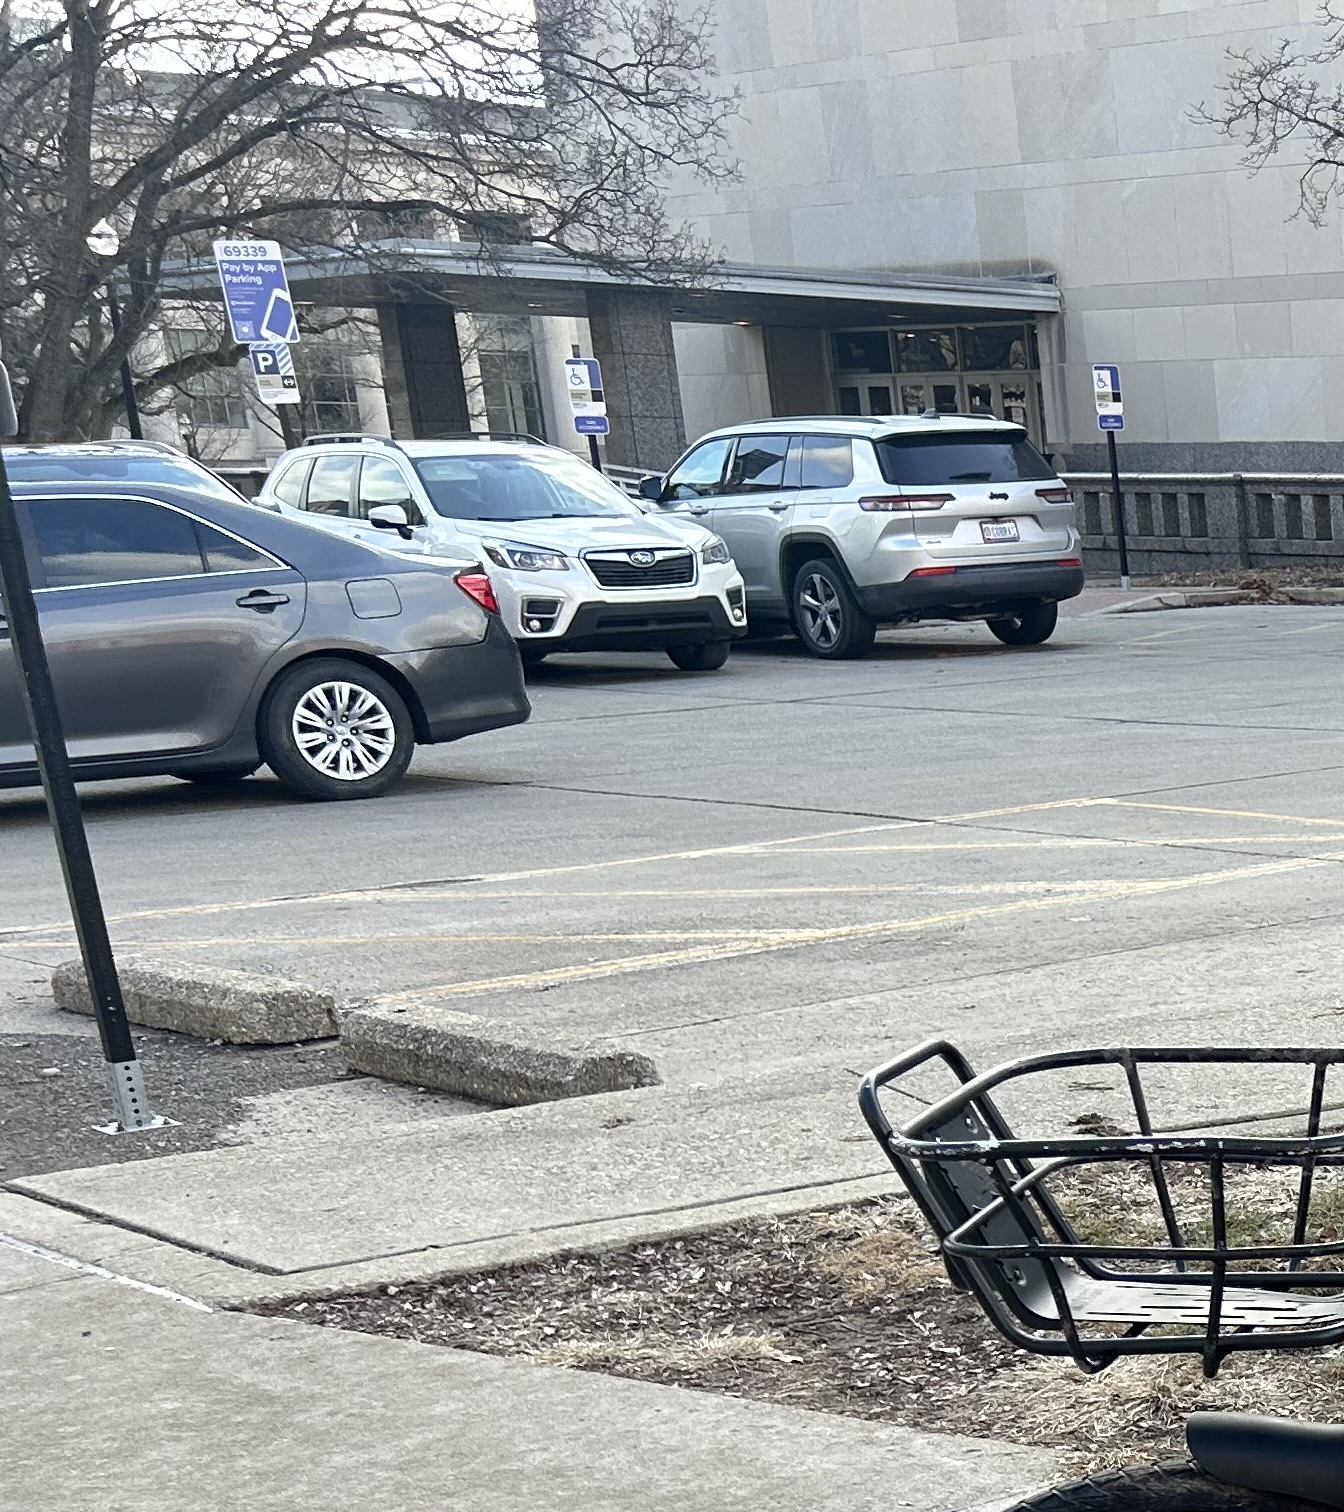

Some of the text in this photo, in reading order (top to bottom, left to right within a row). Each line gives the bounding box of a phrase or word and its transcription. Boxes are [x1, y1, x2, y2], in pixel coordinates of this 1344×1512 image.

[223, 245, 267, 257] 69339
[222, 263, 277, 273] Pay by App
[224, 274, 263, 285] Parking
[256, 352, 274, 373] P
